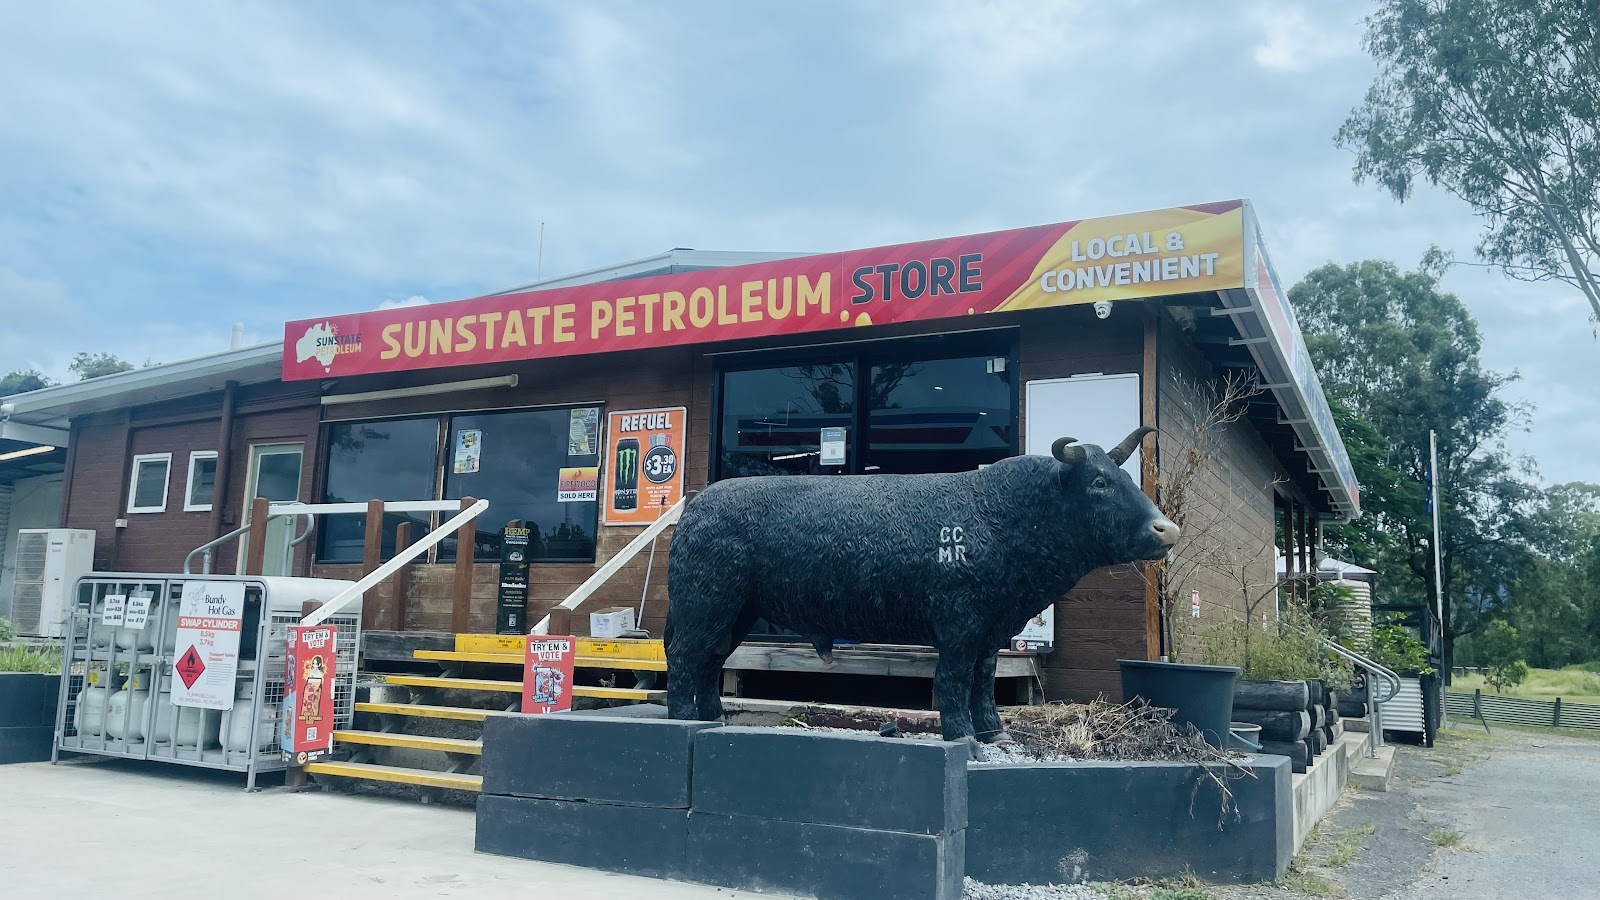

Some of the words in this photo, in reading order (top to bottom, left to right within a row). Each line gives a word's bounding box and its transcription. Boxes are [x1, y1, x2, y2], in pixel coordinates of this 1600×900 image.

[1071, 232, 1159, 262] LOCAL
[1166, 232, 1184, 250] &
[1040, 253, 1219, 293] CONVENIENT
[380, 303, 576, 360] SUNSTATE
[591, 271, 831, 339] PETROLEUM
[851, 253, 983, 305] STORE
[316, 333, 362, 346] SUNSTATE
[315, 343, 362, 356] PETROLEUM
[621, 412, 672, 432] REFUEL
[662, 465, 672, 474] EA
[560, 479, 596, 488] FIREWOOD
[504, 527, 530, 536] HEMP
[940, 526, 963, 543] CC
[938, 545, 966, 562] MR
[204, 594, 226, 606] Bundy
[208, 606, 220, 614] Hot
[222, 606, 236, 616] Gas
[180, 618, 202, 627] SWAP
[202, 619, 238, 629] CYLINDER
[200, 630, 215, 638] 8.5kg
[200, 638, 214, 646] 3.7kg
[532, 643, 546, 652] TRY
[562, 642, 568, 650] &
[540, 651, 560, 659] VOTE
